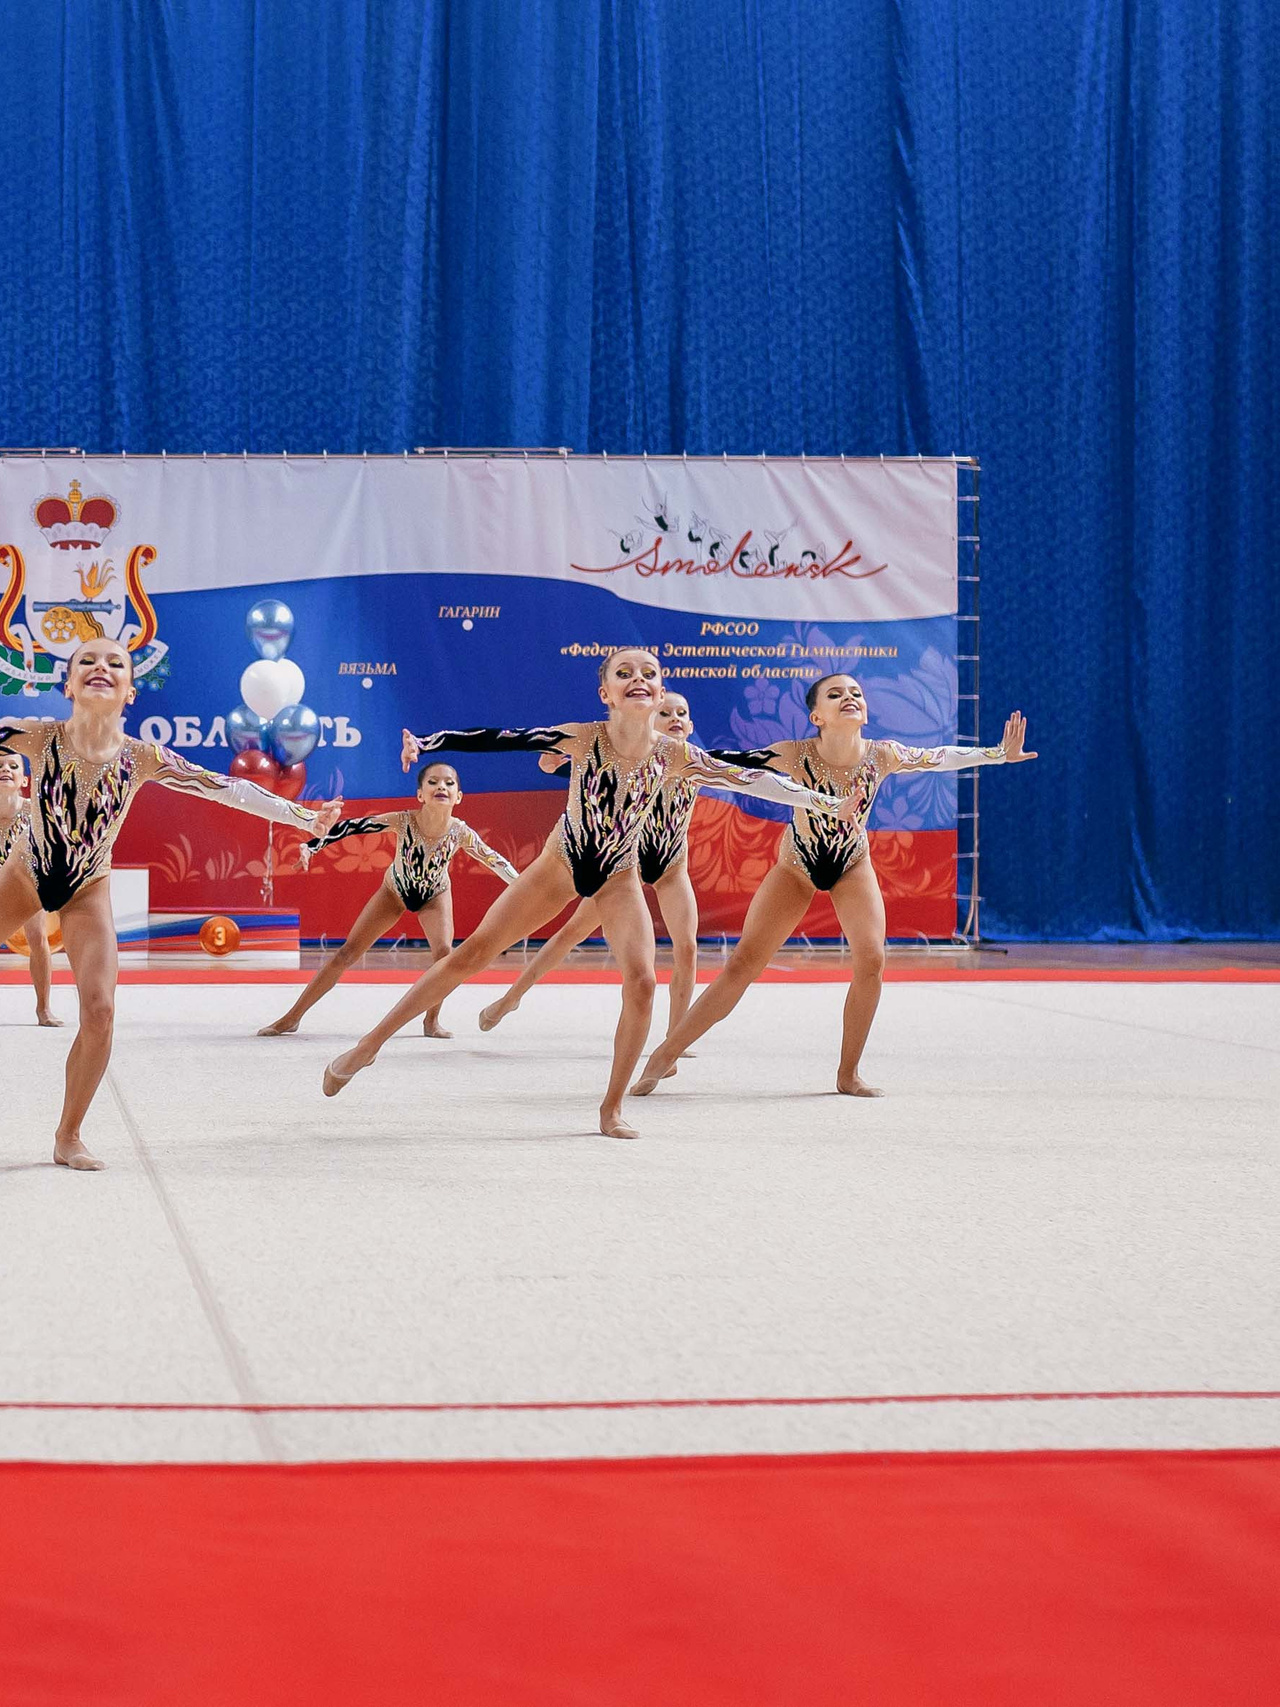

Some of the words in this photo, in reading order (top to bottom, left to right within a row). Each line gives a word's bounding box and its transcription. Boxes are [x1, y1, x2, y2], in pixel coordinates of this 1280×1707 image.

[438, 606, 501, 619] ГАГАРИН
[700, 621, 760, 636] РФСОО
[560, 642, 660, 658] «Федеря
[663, 642, 787, 658] Эстетической
[790, 643, 898, 658] Гимнастики
[338, 662, 398, 675] ВЯЗЬМА
[661, 664, 738, 678] оленской
[139, 715, 362, 748] ОБЛЬ
[214, 926, 226, 946] 3
